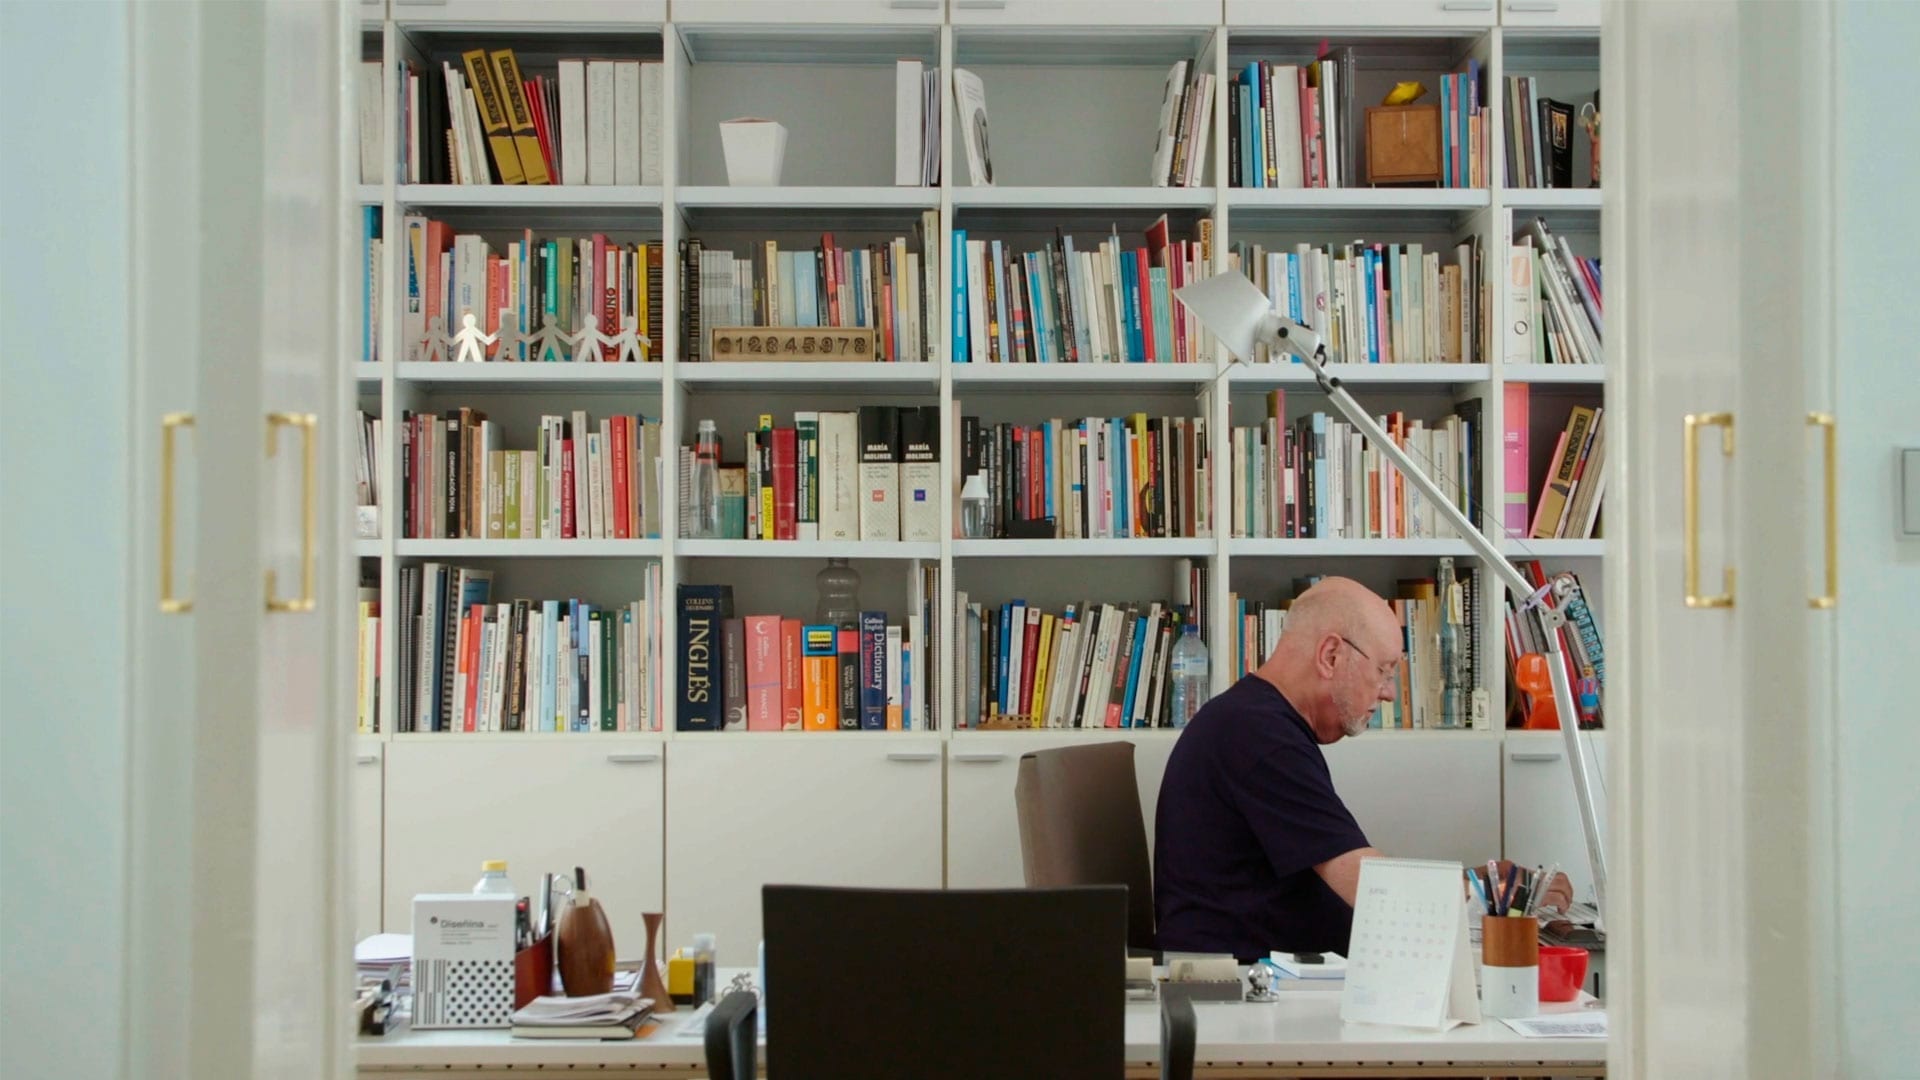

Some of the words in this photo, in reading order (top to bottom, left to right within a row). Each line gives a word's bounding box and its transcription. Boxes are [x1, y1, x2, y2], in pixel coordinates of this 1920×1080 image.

[605, 287, 616, 355] UOXUNO
[867, 443, 888, 451] MARÍA
[908, 443, 930, 451] MARÍA
[688, 619, 711, 702] INGLÉS
[872, 633, 885, 690] Dictionary
[843, 718, 857, 727] VOX
